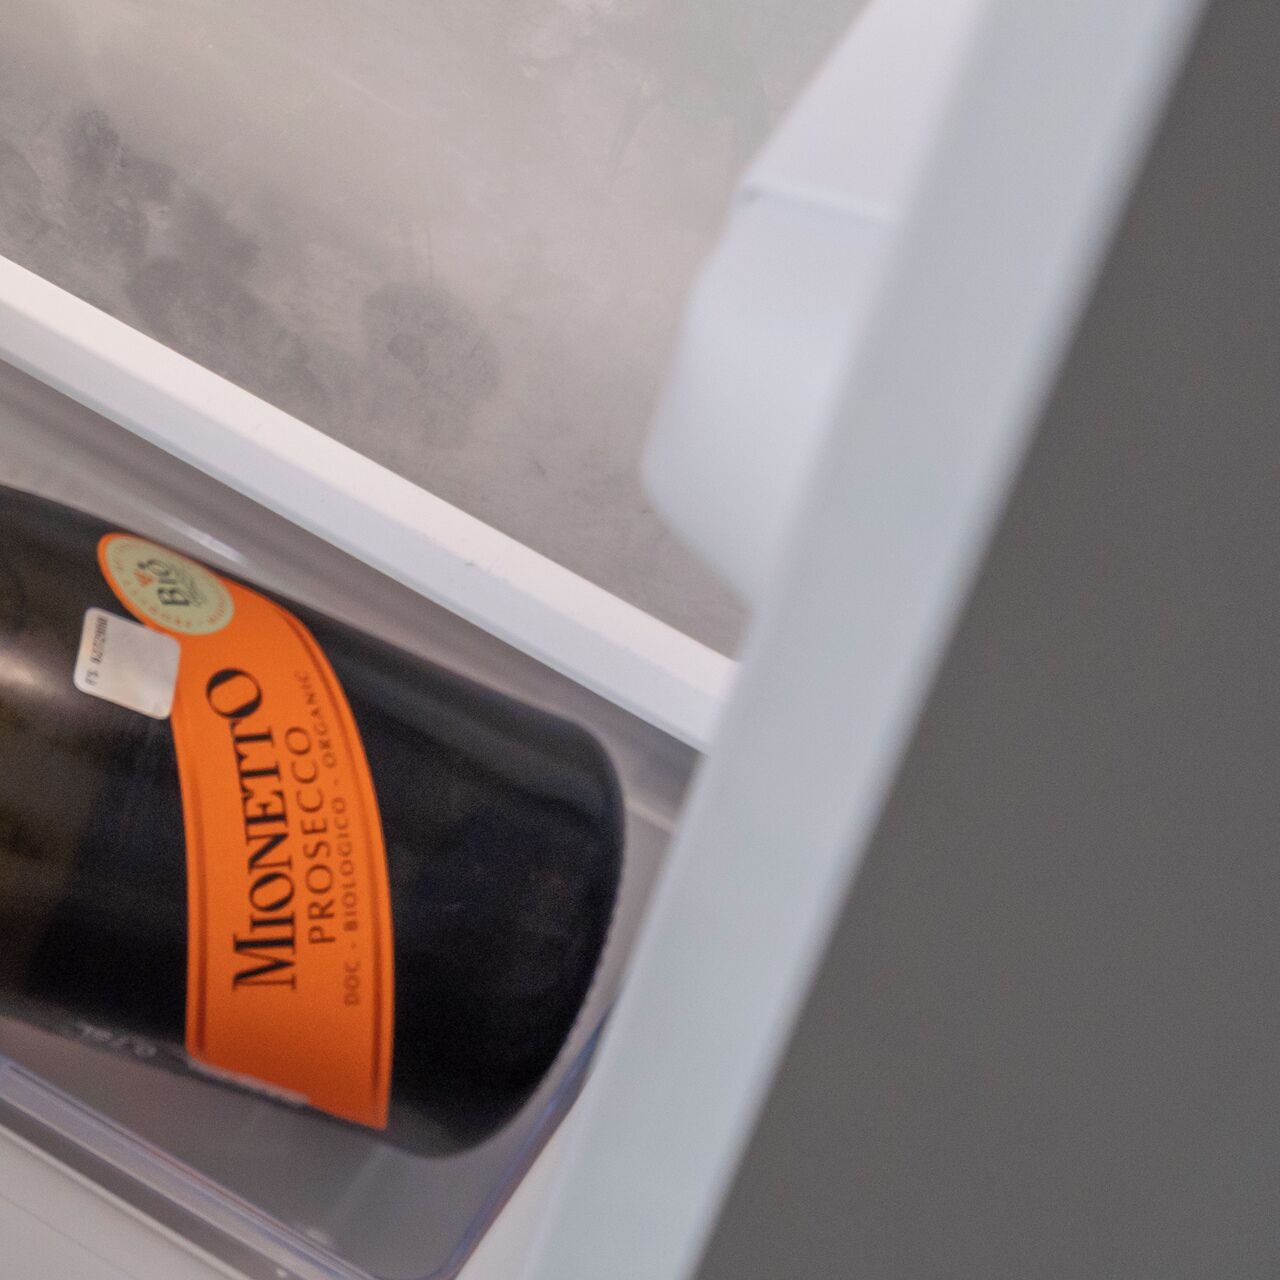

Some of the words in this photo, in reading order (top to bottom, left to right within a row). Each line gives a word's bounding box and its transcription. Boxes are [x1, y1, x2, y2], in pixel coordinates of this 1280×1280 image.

[294, 671, 337, 769] ORGANIC
[205, 668, 297, 993] MIONETTO
[285, 726, 336, 945] PROSECCO
[332, 797, 358, 933] BIOLOGICO
[344, 960, 360, 1007] DOC
